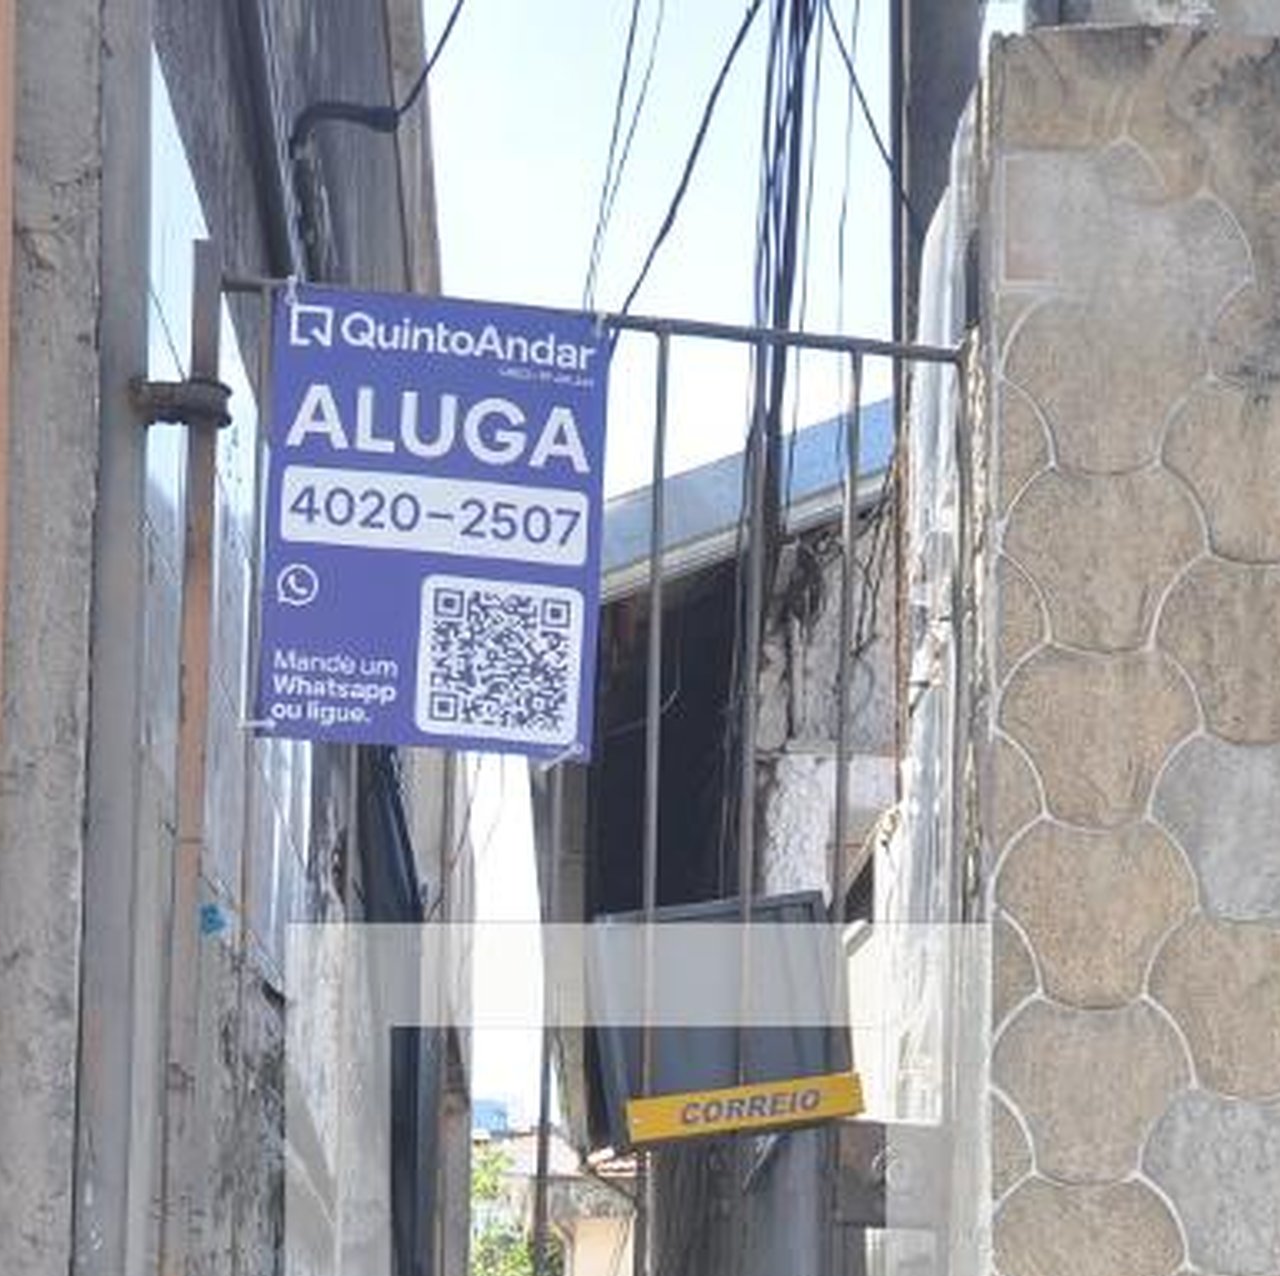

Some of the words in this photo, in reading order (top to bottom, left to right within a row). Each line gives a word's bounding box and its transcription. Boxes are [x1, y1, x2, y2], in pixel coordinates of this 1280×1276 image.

[341, 313, 596, 370] QuintoAndar
[287, 384, 590, 473] ALUGA
[290, 485, 582, 547] 4020-2507
[274, 650, 355, 674] Mande
[360, 659, 398, 677] um
[274, 675, 397, 705] Whatsapp
[271, 702, 302, 719] ou
[681, 1091, 820, 1125] CORREIO
